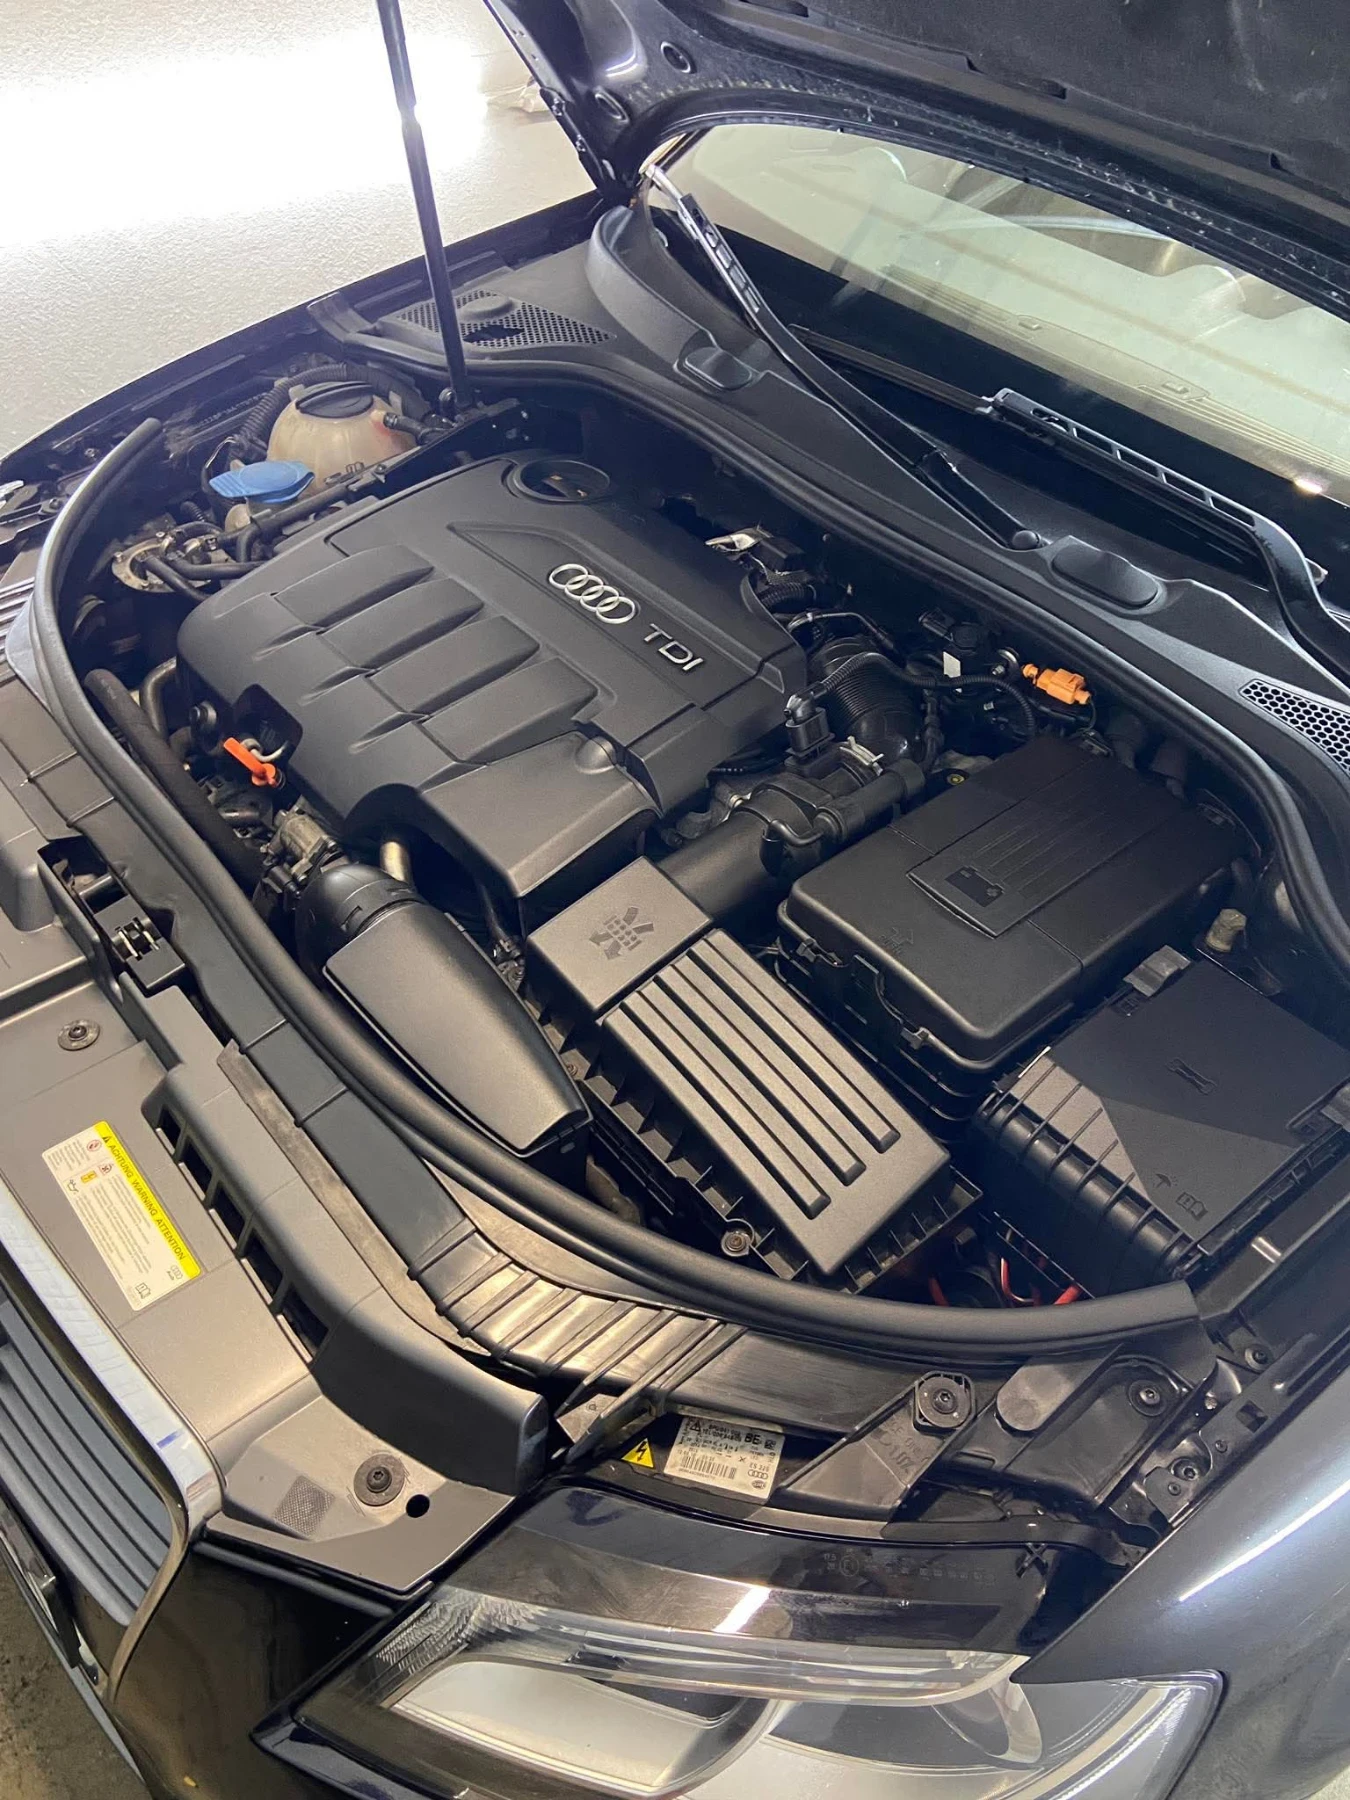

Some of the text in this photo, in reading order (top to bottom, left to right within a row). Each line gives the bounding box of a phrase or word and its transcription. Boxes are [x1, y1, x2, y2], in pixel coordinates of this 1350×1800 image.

[644, 623, 703, 671] TDI
[108, 1144, 133, 1178] ACHTUNG
[132, 1179, 158, 1217] WARNING
[155, 1218, 186, 1260] ATTENTION
